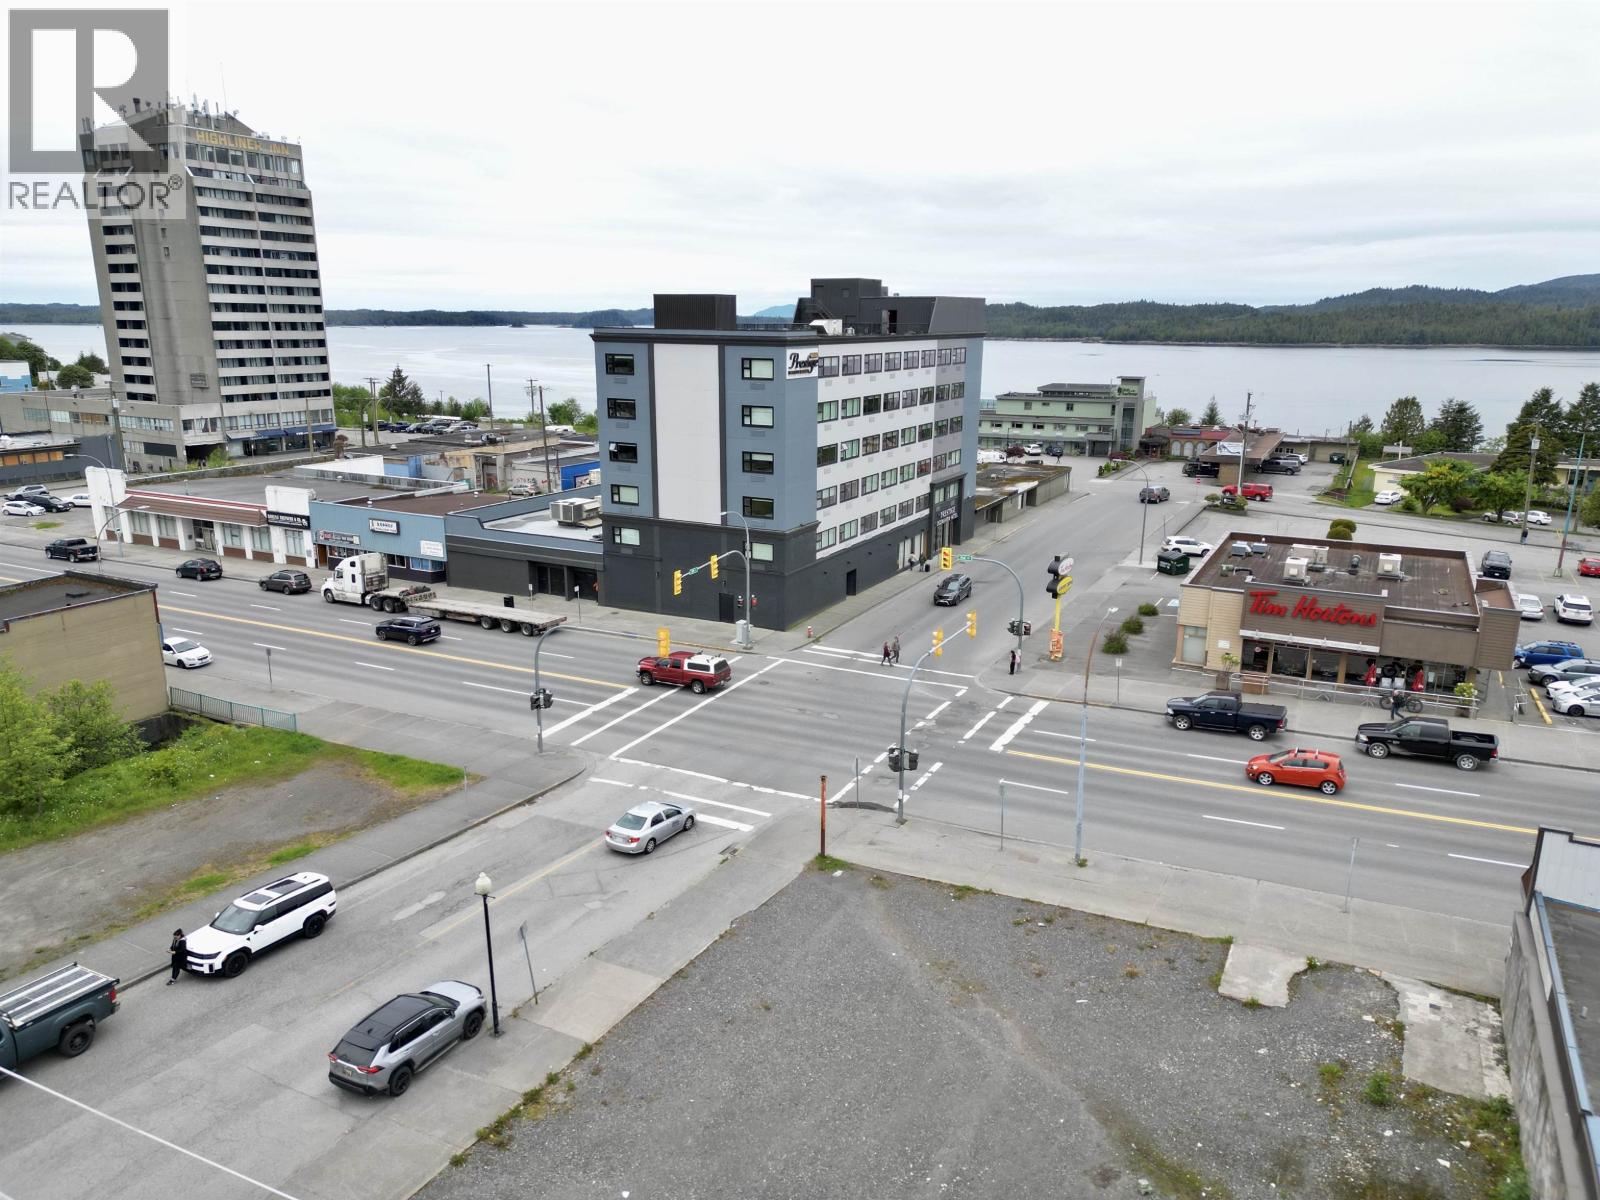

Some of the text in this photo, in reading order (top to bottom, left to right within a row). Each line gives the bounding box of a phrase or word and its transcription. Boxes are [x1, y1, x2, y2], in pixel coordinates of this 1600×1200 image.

[269, 143, 289, 156] INN
[1249, 591, 1377, 627] Tim Hortons
